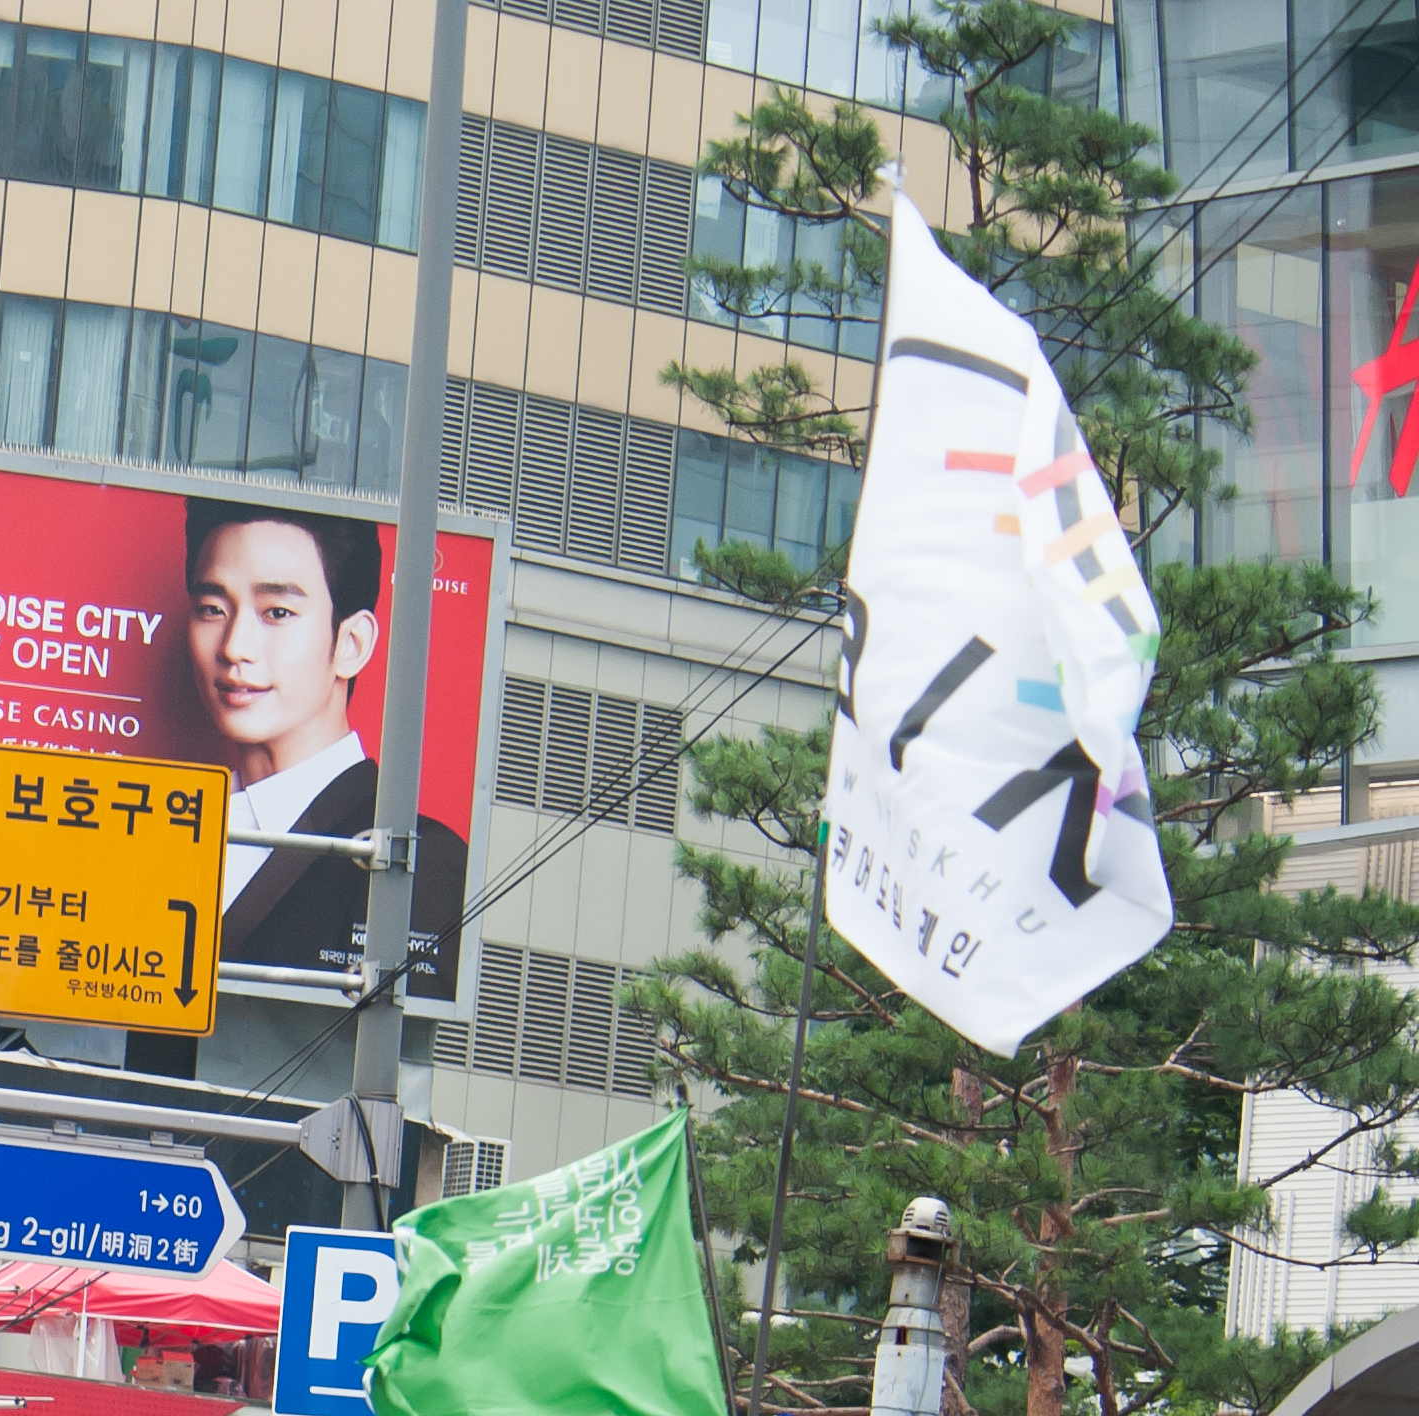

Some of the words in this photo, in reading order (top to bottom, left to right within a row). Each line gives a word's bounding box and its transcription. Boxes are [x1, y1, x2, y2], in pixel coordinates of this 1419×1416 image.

[75, 604, 163, 645] CITY
[12, 637, 110, 678] OPEN
[33, 704, 142, 739] CASINO
[56, 938, 168, 980] 줄이시오
[66, 977, 164, 1006] 우전방40m
[21, 1216, 200, 1268] 2-gil/明洞2街
[308, 1246, 402, 1361] P
